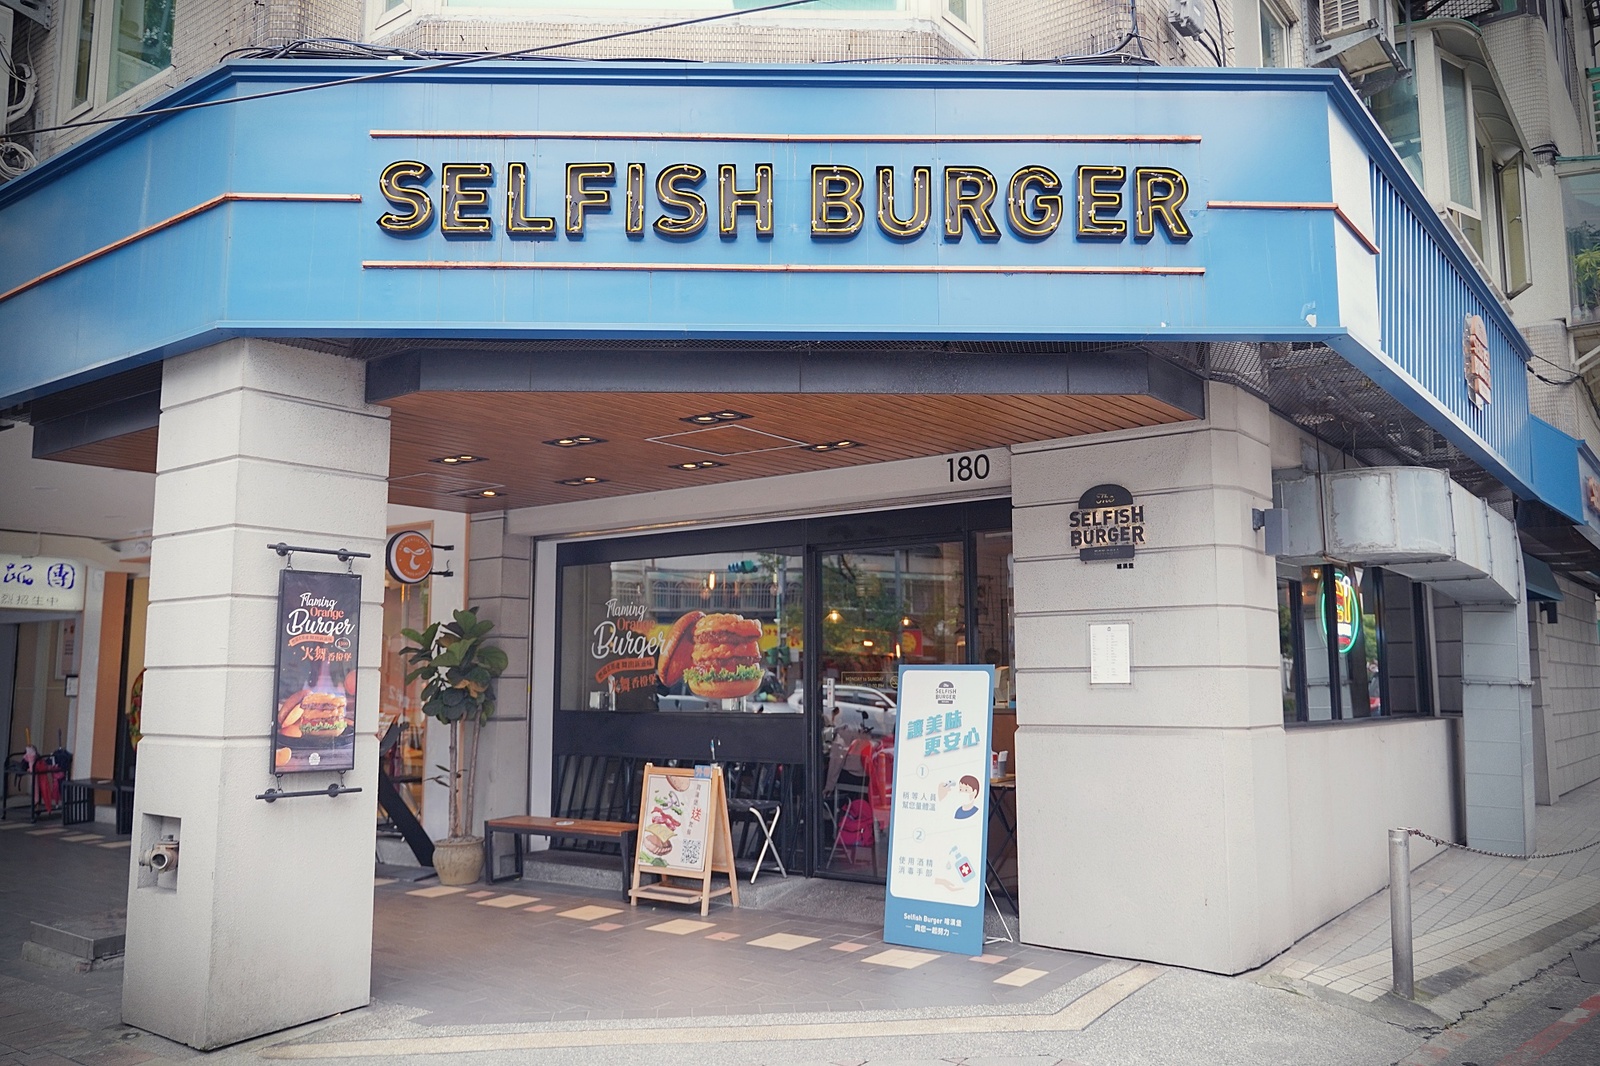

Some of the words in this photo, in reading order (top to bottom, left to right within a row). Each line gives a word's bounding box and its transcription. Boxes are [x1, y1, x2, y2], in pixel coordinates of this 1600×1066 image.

[376, 160, 775, 240] SELFISH
[809, 164, 1193, 244] BURGER
[946, 454, 990, 482] 180
[1069, 506, 1144, 527] SELFISH
[1070, 526, 1145, 547] BURGER
[300, 592, 338, 610] Flaming
[605, 598, 647, 621] Flaming
[286, 608, 355, 636] Burger
[310, 607, 344, 620] Orange
[616, 617, 656, 632] Orange
[591, 621, 674, 659] Burger
[907, 709, 962, 740] 讓美味
[924, 727, 980, 757] 更安心
[903, 912, 922, 921] Selfish
[923, 915, 943, 925] Burger
